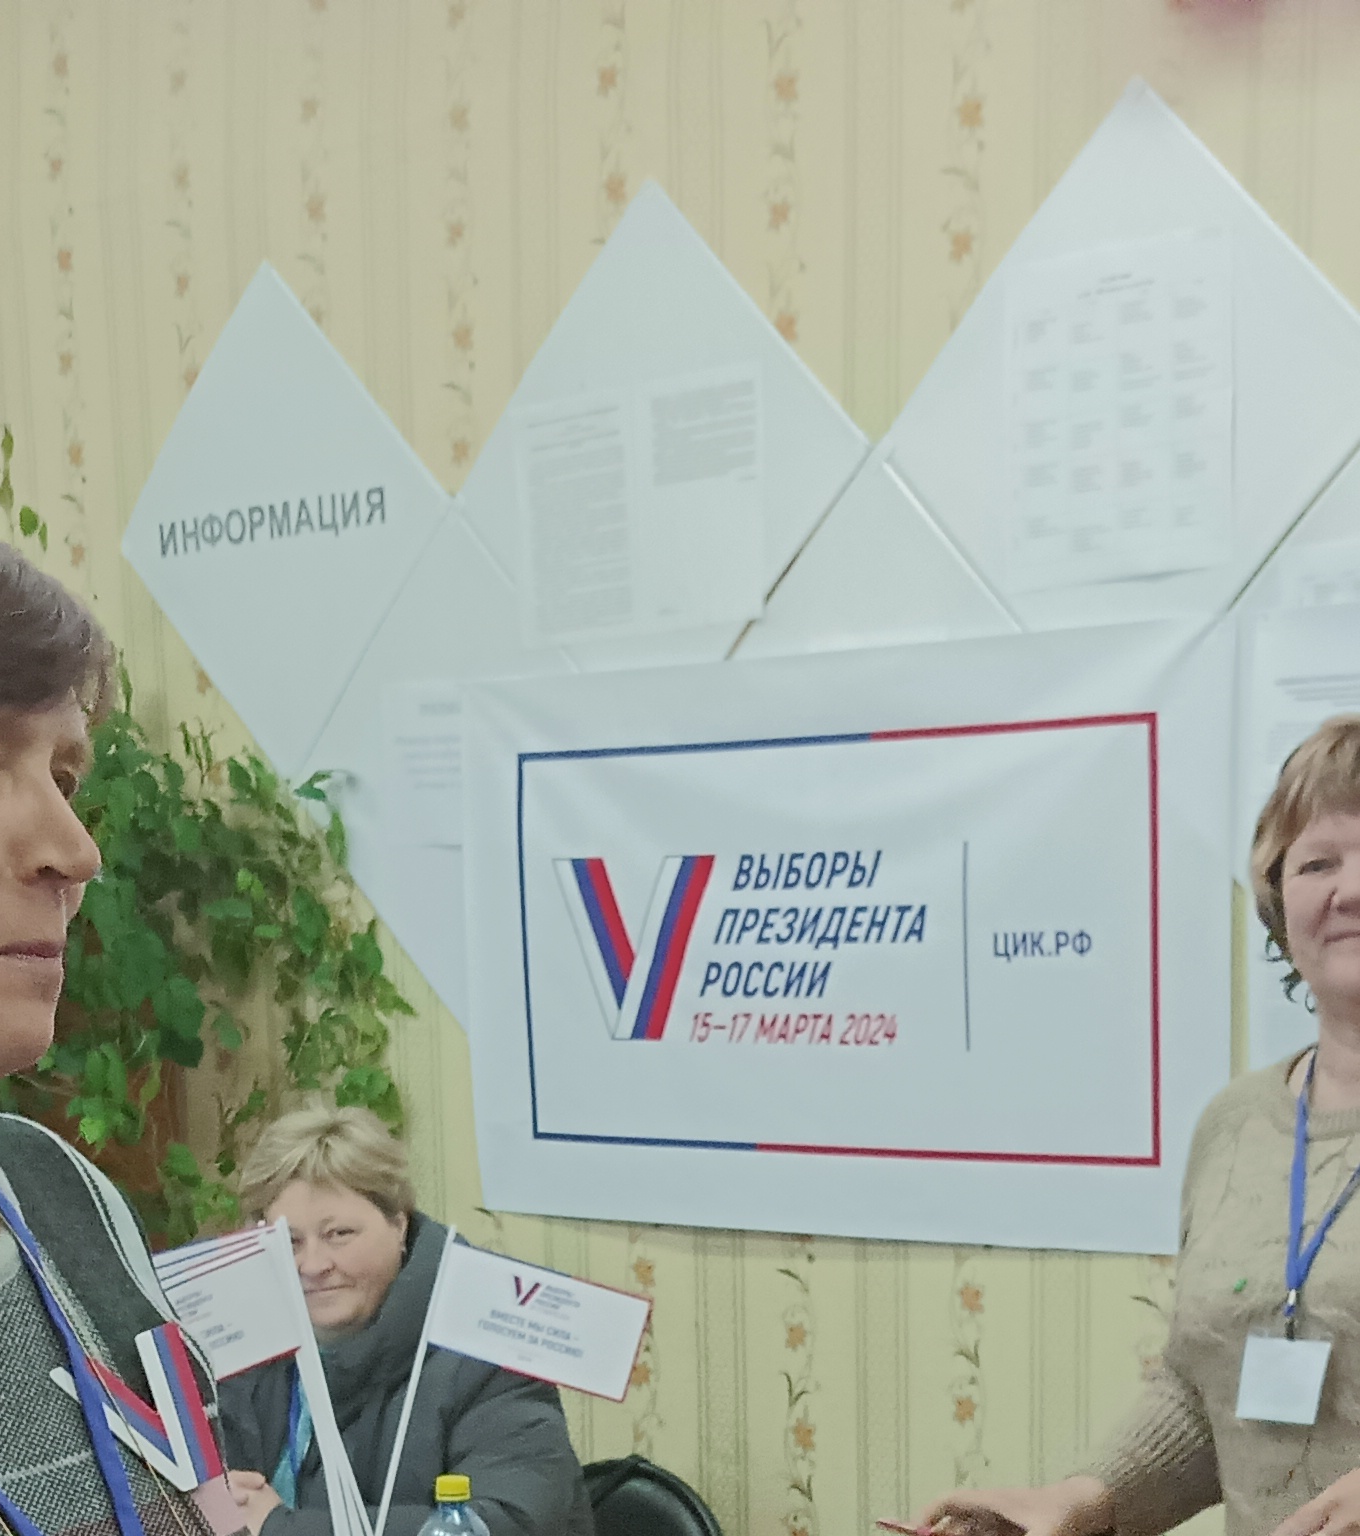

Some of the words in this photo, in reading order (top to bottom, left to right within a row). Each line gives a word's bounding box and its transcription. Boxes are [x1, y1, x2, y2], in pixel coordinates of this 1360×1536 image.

[157, 486, 387, 559] ИНФОРМАЦИЯ
[732, 850, 883, 892] ВЫБОРЫ
[713, 904, 928, 951] ПРЕЗИДЕНТА
[992, 930, 1093, 962] ЦИК.РФ
[699, 960, 834, 999] РОССИИ
[753, 1013, 834, 1045] МАРТА
[838, 1013, 899, 1047] 2024
